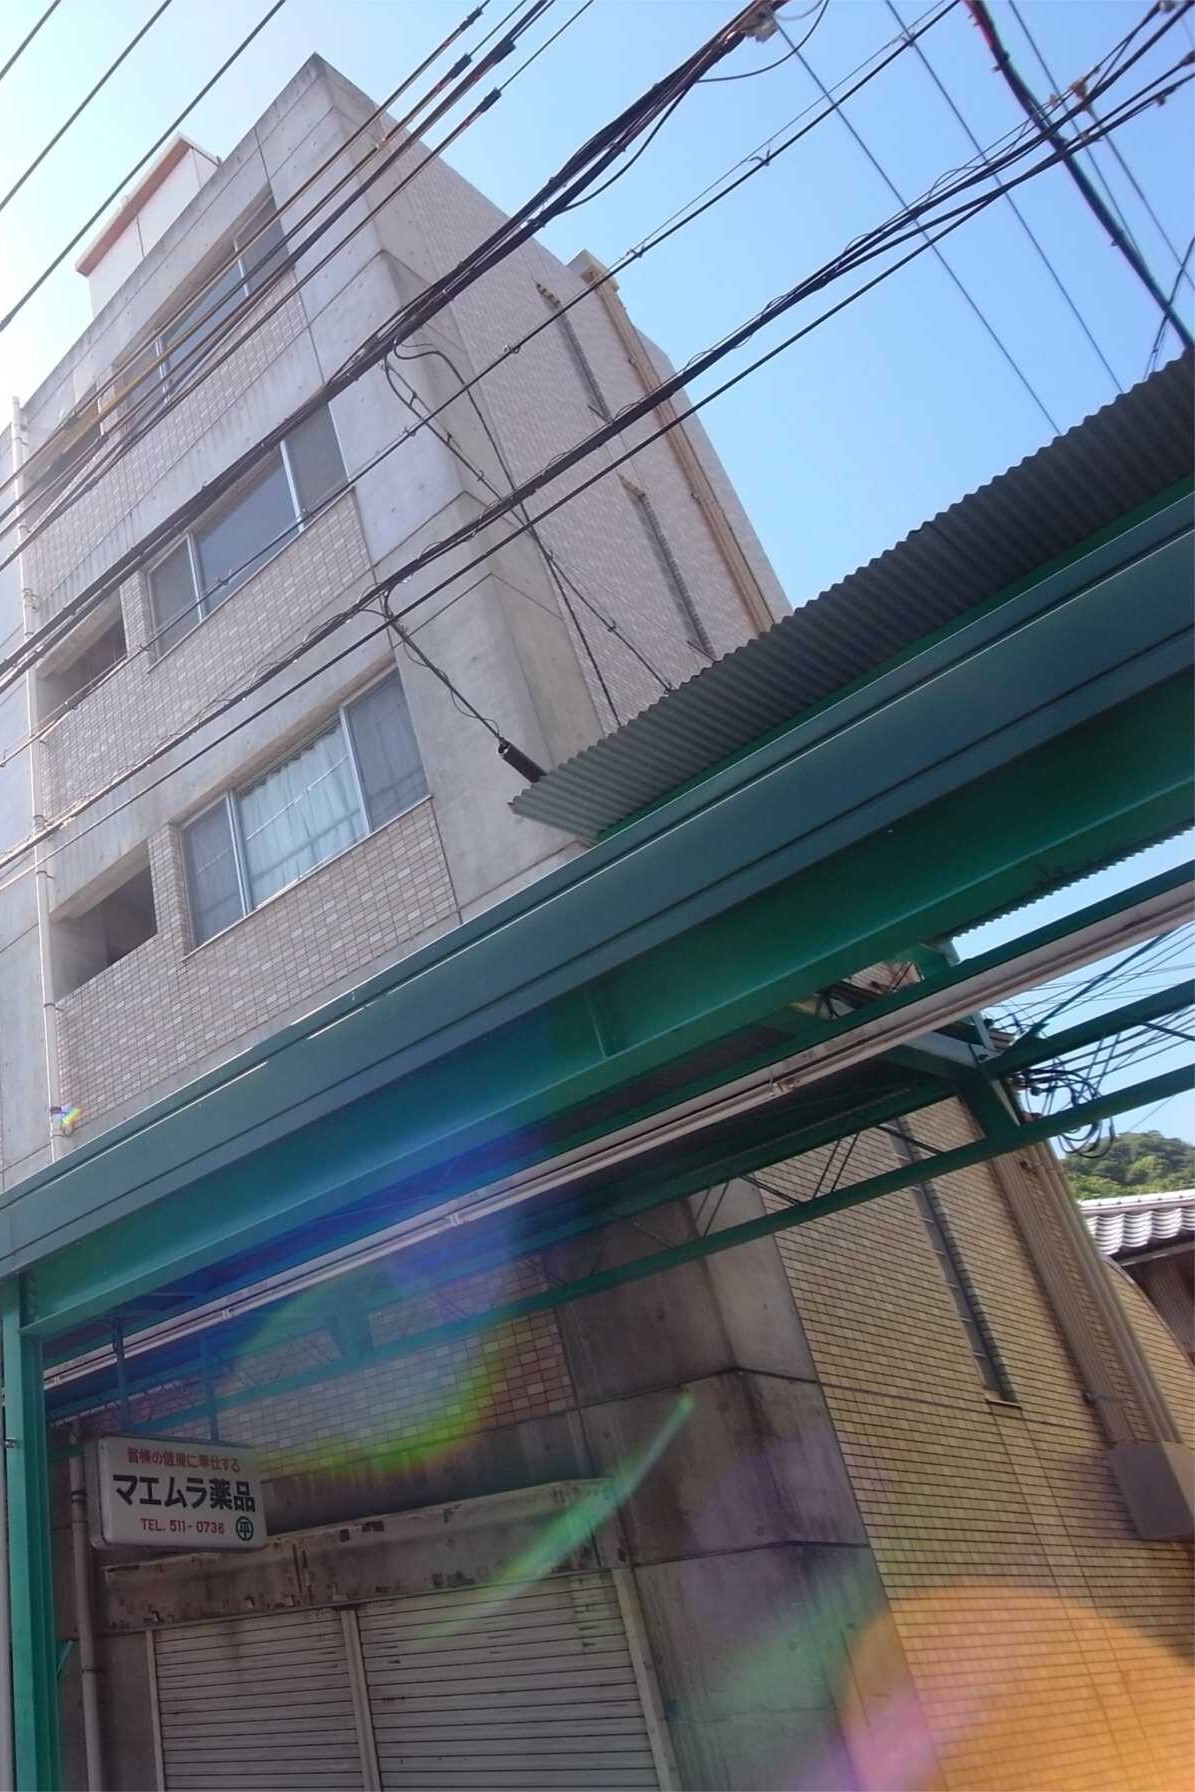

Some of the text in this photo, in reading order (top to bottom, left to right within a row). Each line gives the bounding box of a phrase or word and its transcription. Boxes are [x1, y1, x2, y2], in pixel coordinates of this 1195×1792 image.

[113, 1474, 256, 1512] マエムラ薬品
[141, 1518, 165, 1531] TEL.
